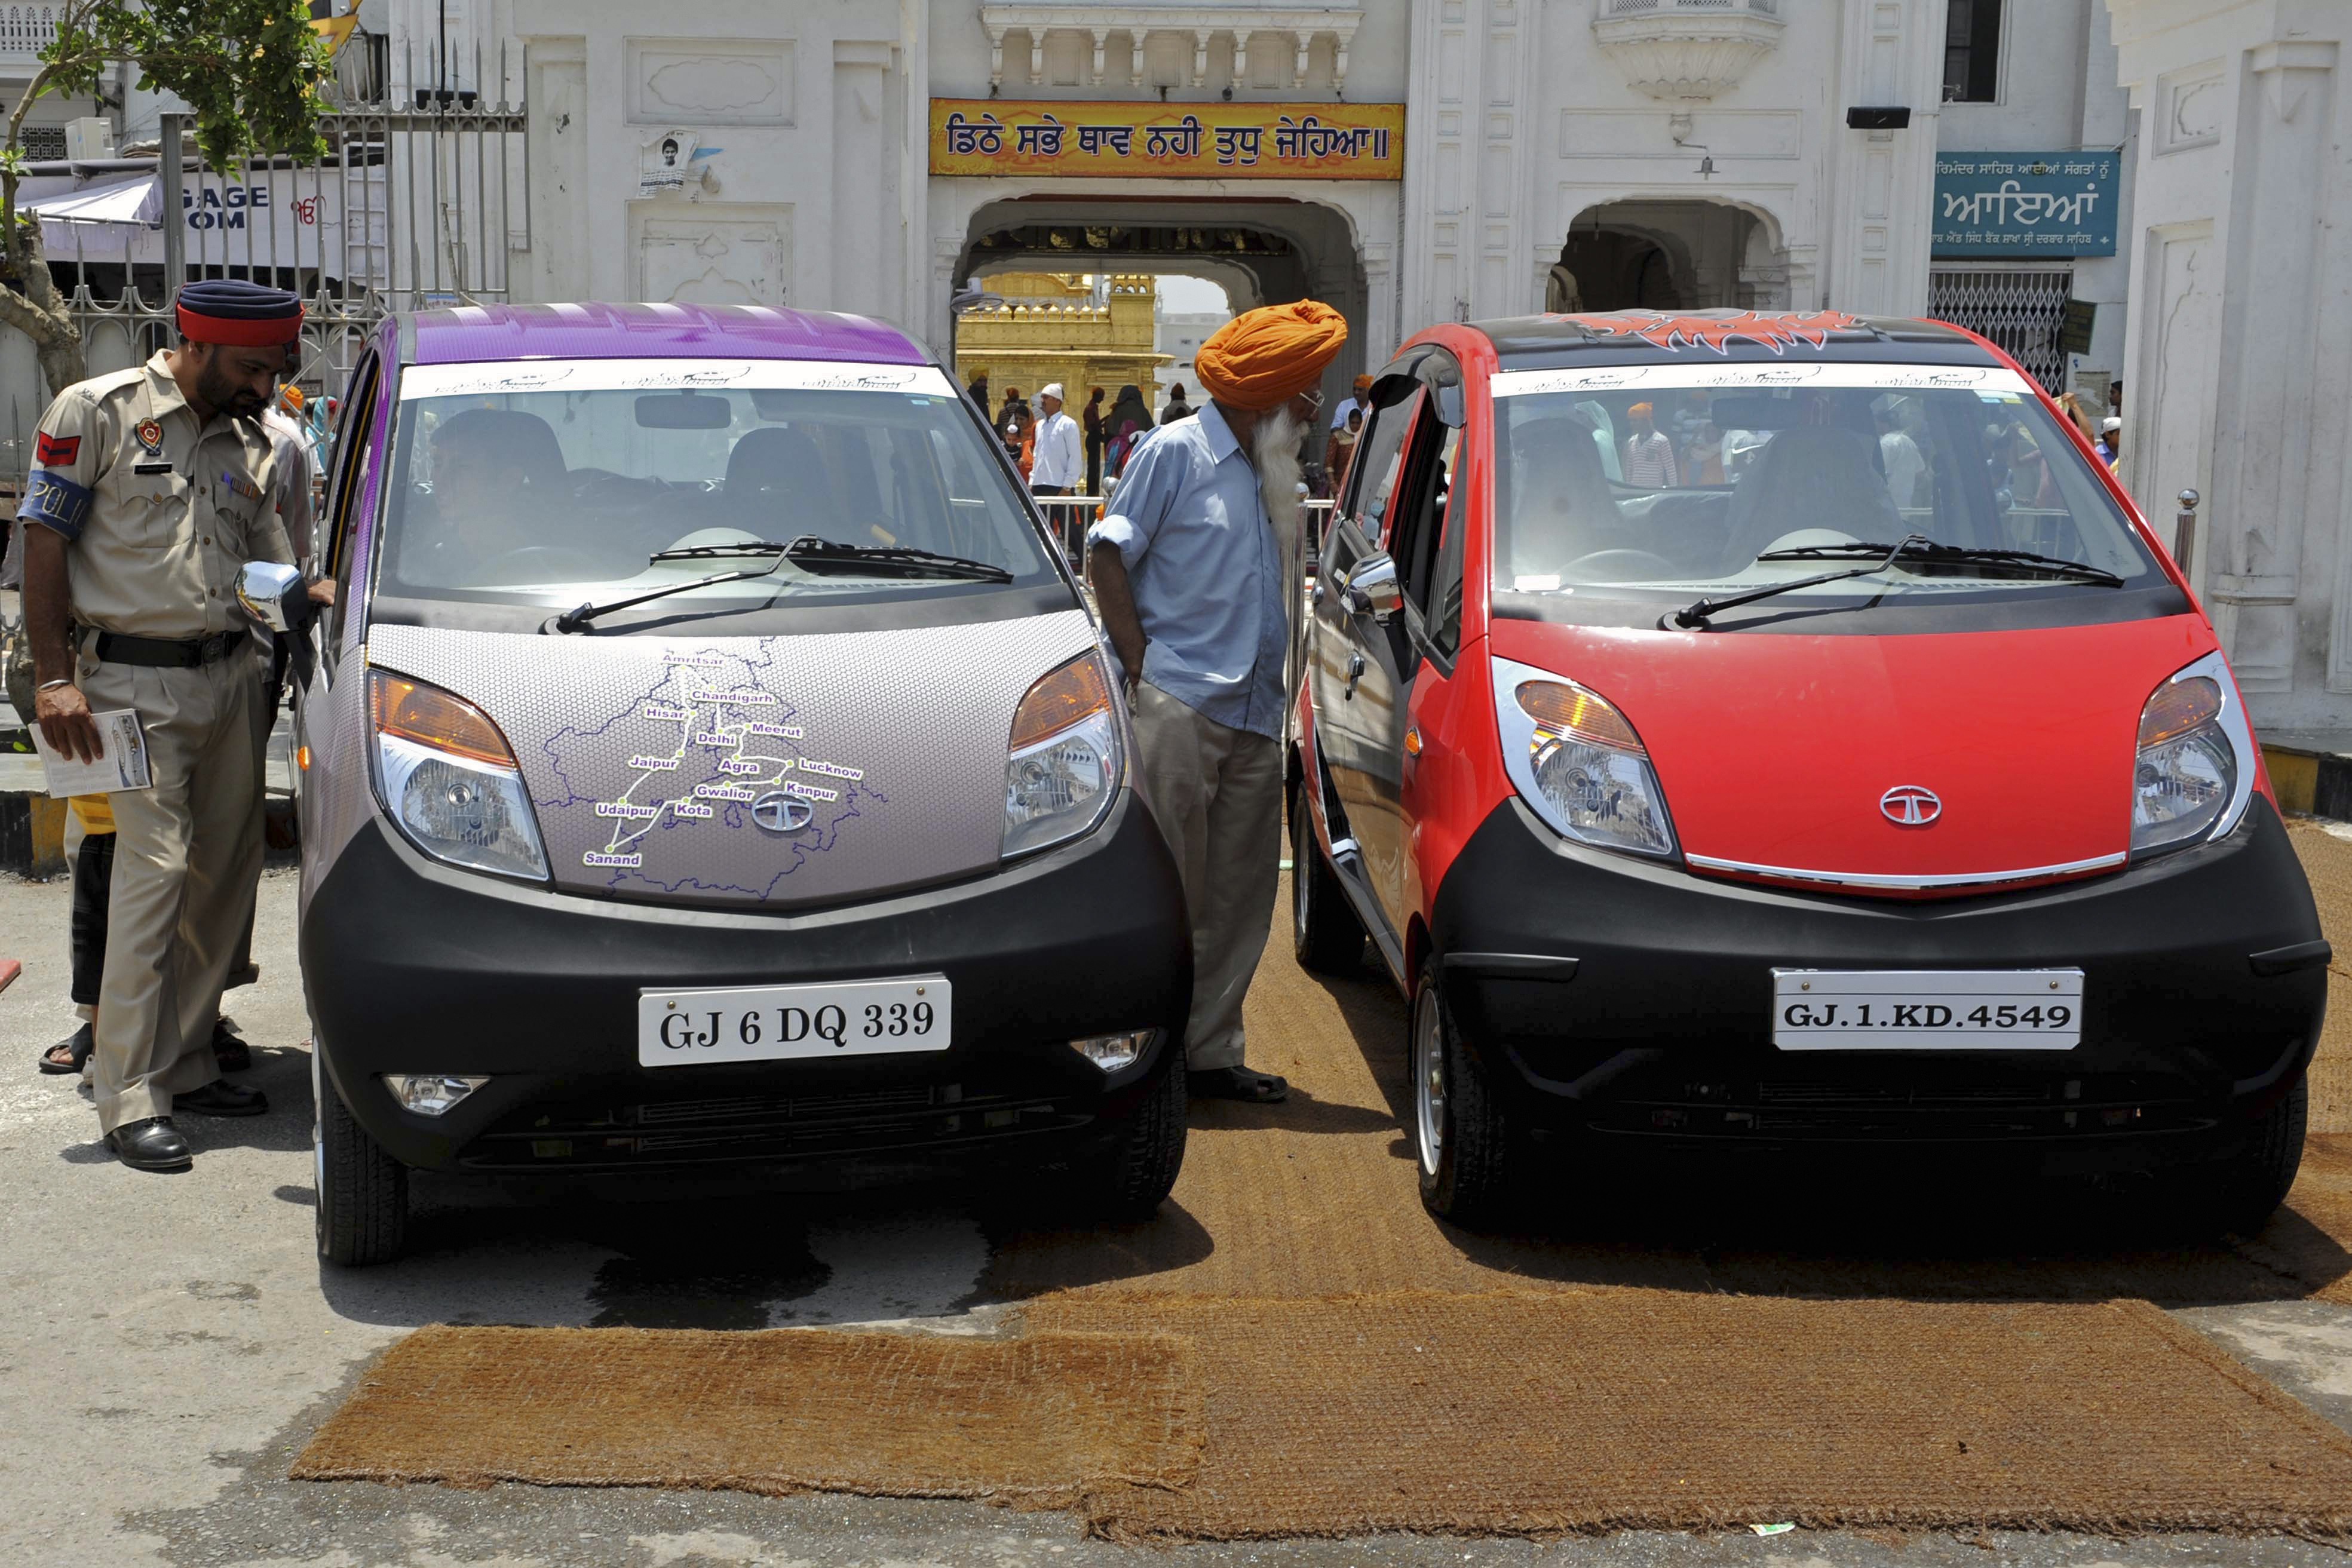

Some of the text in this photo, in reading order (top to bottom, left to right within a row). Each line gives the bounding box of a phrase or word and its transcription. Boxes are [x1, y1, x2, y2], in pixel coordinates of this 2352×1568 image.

[946, 112, 1004, 154] ਡਿਠੇ
[1016, 113, 1065, 155] ਸਭੇ
[1077, 125, 1134, 157] ਥਾਵ
[1145, 115, 1203, 157] ਨਹੀ
[1214, 127, 1264, 165] ਤੁਧੁ
[1935, 160, 1975, 174] ਰਿਮੰਦਰ
[1979, 160, 2014, 174] ਸਾਹਿਬ
[1943, 180, 2099, 225] ਆਇਆਂ
[663, 655, 724, 665] Amritsar
[692, 691, 772, 703] Chandigarh
[647, 708, 684, 718] Hisar
[753, 724, 801, 737] Meerut
[698, 734, 735, 744] Delhi
[631, 757, 676, 769] Jaipur
[721, 760, 758, 773] Agra
[801, 759, 861, 778] Lucknow
[697, 786, 753, 799] Gwalior
[787, 783, 835, 800] Kanpur
[598, 805, 655, 817] Udaipur
[677, 805, 711, 815] Kota
[585, 853, 640, 865] Sanand
[1784, 1004, 2071, 1029] GJ.1.KD.4549
[660, 1002, 934, 1050] GJ 6 DQ 339
